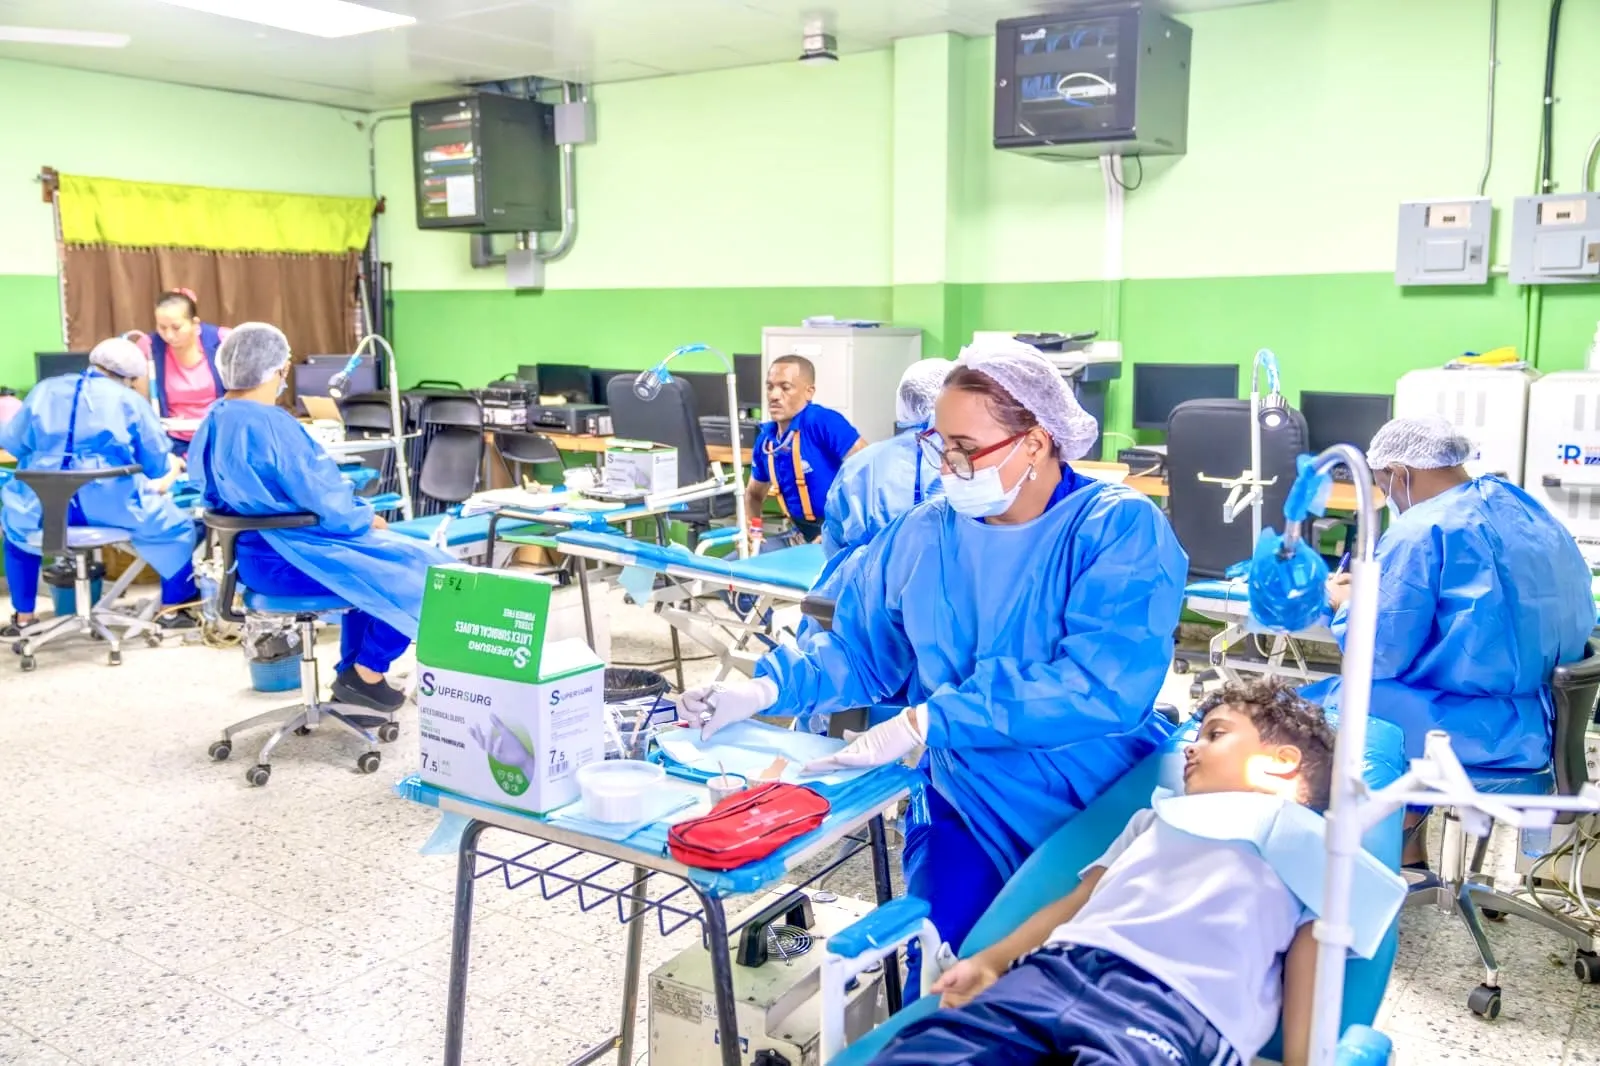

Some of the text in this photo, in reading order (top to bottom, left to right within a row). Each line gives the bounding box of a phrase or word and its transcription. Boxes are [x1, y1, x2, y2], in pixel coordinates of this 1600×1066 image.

[448, 577, 463, 591] 7.5
[454, 621, 480, 635] GLOVES
[510, 632, 533, 645] LATEX
[468, 641, 532, 668] SUPERSURG
[420, 672, 492, 706] SUPERSURG
[420, 752, 438, 773] 7.5
[549, 750, 565, 764] 7.5
